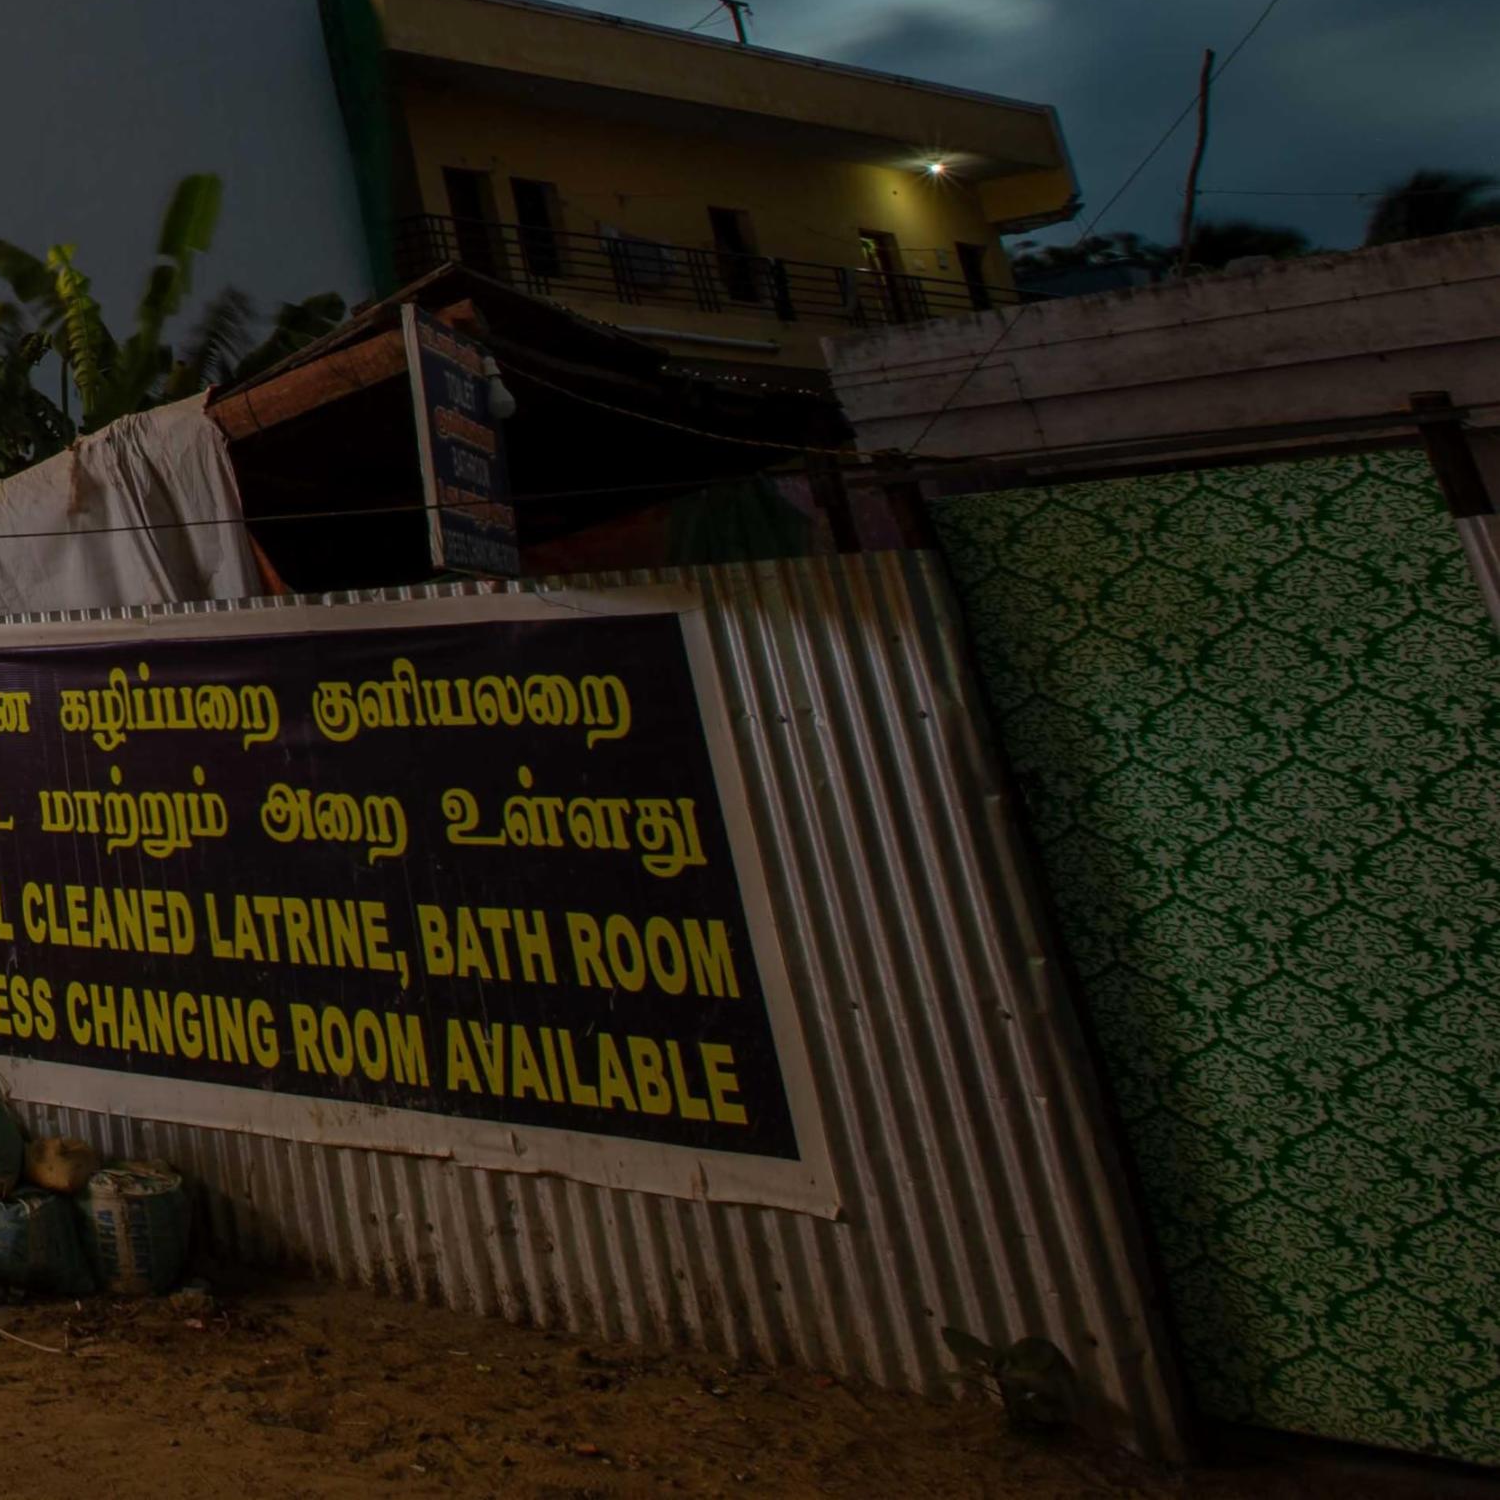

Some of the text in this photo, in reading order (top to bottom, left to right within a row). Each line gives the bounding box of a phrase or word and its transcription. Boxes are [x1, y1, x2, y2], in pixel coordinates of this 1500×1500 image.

[59, 660, 281, 752] கழிப்பறை
[311, 656, 632, 750] குளியலறை
[39, 763, 229, 860] மாற்றும்
[260, 781, 408, 866] அறை
[441, 763, 708, 878] உள்ளது
[21, 881, 195, 956] CLEANED
[207, 893, 412, 990] LATRINE,
[422, 904, 559, 986] BATH
[568, 912, 742, 1000] ROOM
[66, 981, 280, 1070] CHANGING
[291, 1002, 430, 1088] ROOM
[445, 1018, 749, 1127] AVAILABLE
